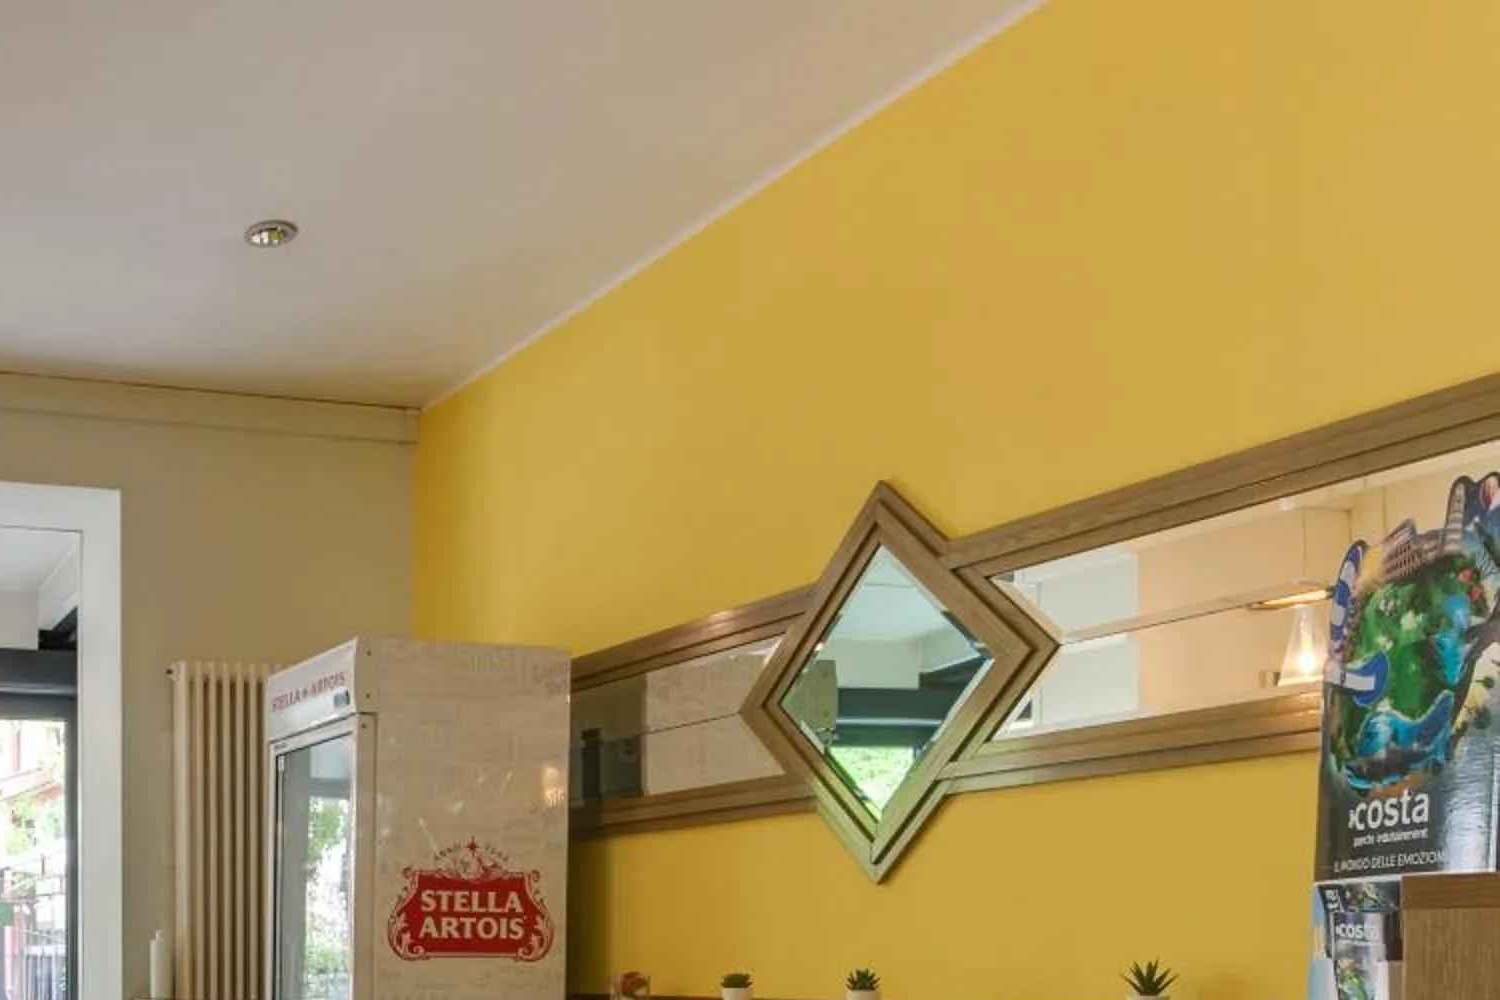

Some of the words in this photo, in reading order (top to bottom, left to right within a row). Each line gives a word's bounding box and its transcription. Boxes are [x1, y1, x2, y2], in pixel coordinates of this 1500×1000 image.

[1397, 848, 1448, 867] EMOZION
[420, 889, 524, 913] STELLA
[419, 916, 525, 940] ARTOIS
